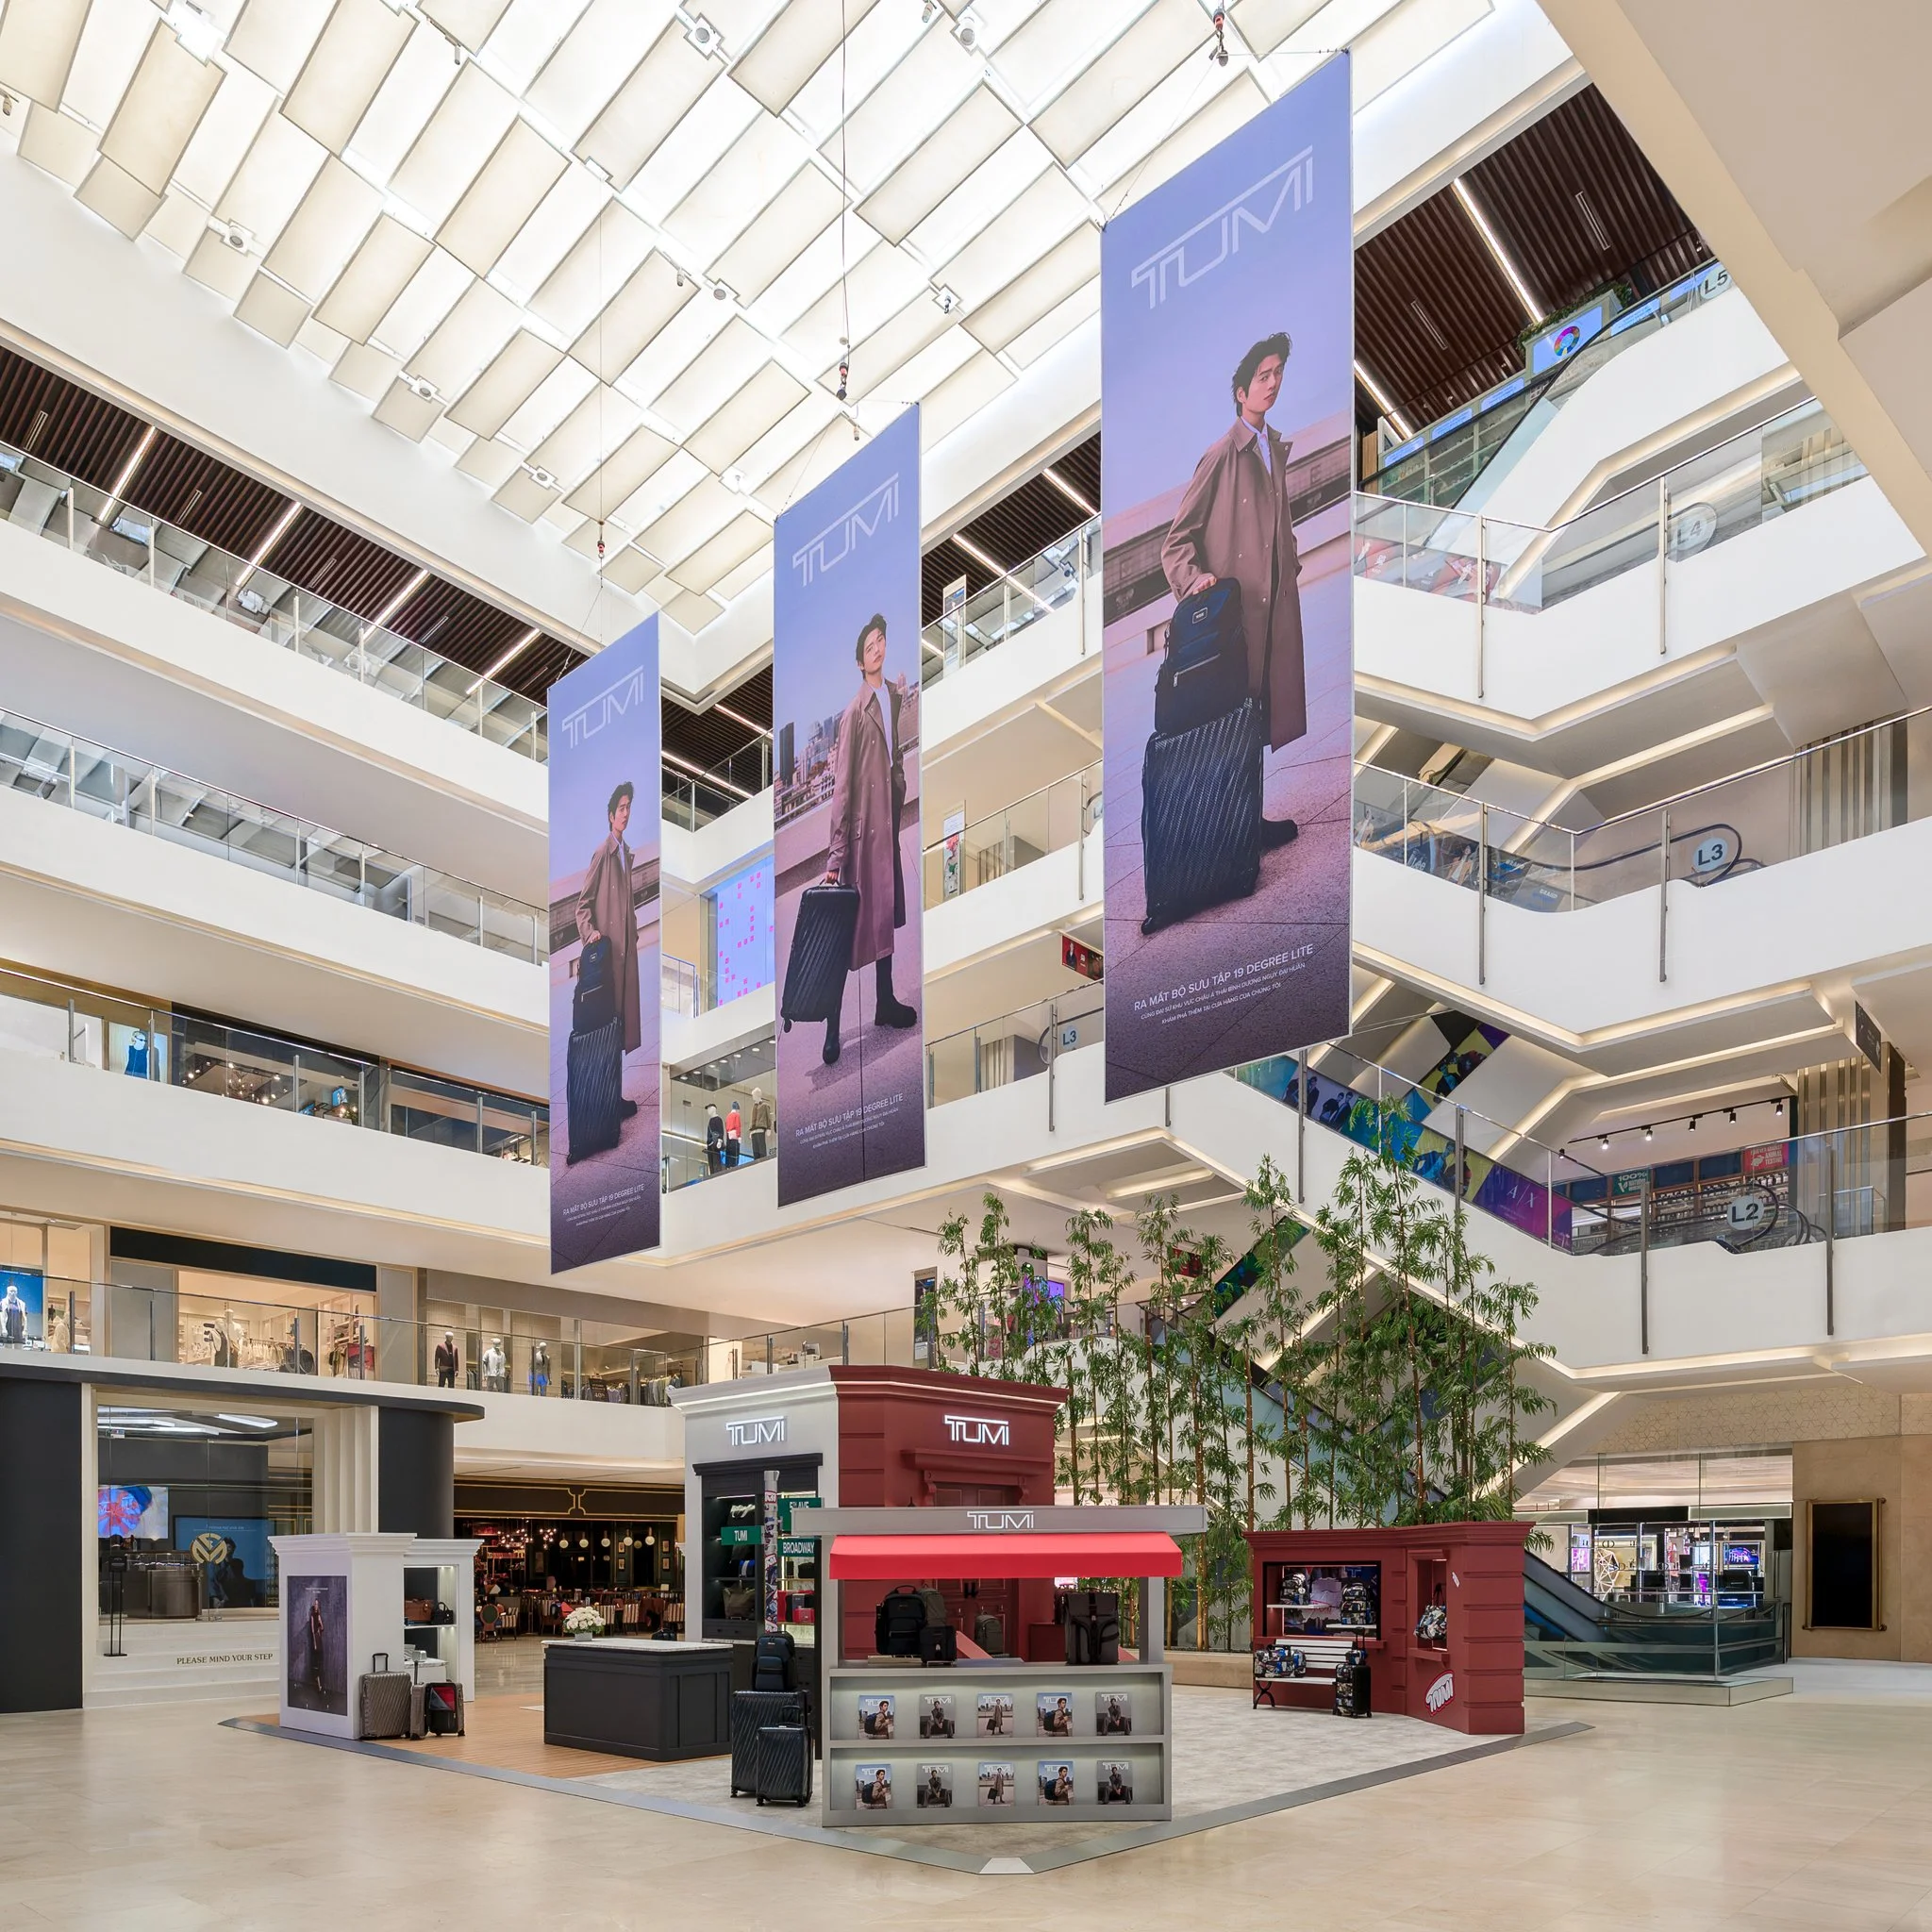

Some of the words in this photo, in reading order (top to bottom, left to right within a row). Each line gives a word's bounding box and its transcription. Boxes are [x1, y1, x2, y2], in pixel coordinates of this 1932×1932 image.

[1131, 144, 1313, 309] TUMI
[1704, 269, 1727, 294] L5
[792, 473, 898, 587] TUMI
[1677, 520, 1702, 545] L4
[562, 664, 644, 749] TUMI
[1698, 843, 1724, 866] L3
[1134, 999, 1147, 1011] RA
[1172, 984, 1186, 998] BỘ
[1211, 971, 1231, 985] TẬP
[1233, 967, 1244, 978] 19
[1246, 951, 1289, 974] DEGREE
[1291, 943, 1313, 960] LITE
[1062, 1029, 1077, 1046] L3
[795, 1127, 805, 1137] RA
[855, 1107, 862, 1117] 19
[863, 1097, 889, 1114] DEGREE
[889, 1092, 904, 1105] LITE
[1618, 1171, 1647, 1182] 100%
[1731, 1202, 1758, 1223] L2
[725, 1415, 785, 1446] TUMI
[943, 1414, 1009, 1445] TUMI
[967, 1510, 1034, 1529] TUMI
[734, 1529, 748, 1541] TUMI
[782, 1541, 815, 1554] BROADWAY
[176, 1656, 208, 1665] PLEASE
[208, 1654, 230, 1663] MIND
[231, 1653, 253, 1662] YOUR
[254, 1652, 274, 1660] STEP
[1425, 1672, 1454, 1713] TUMI
